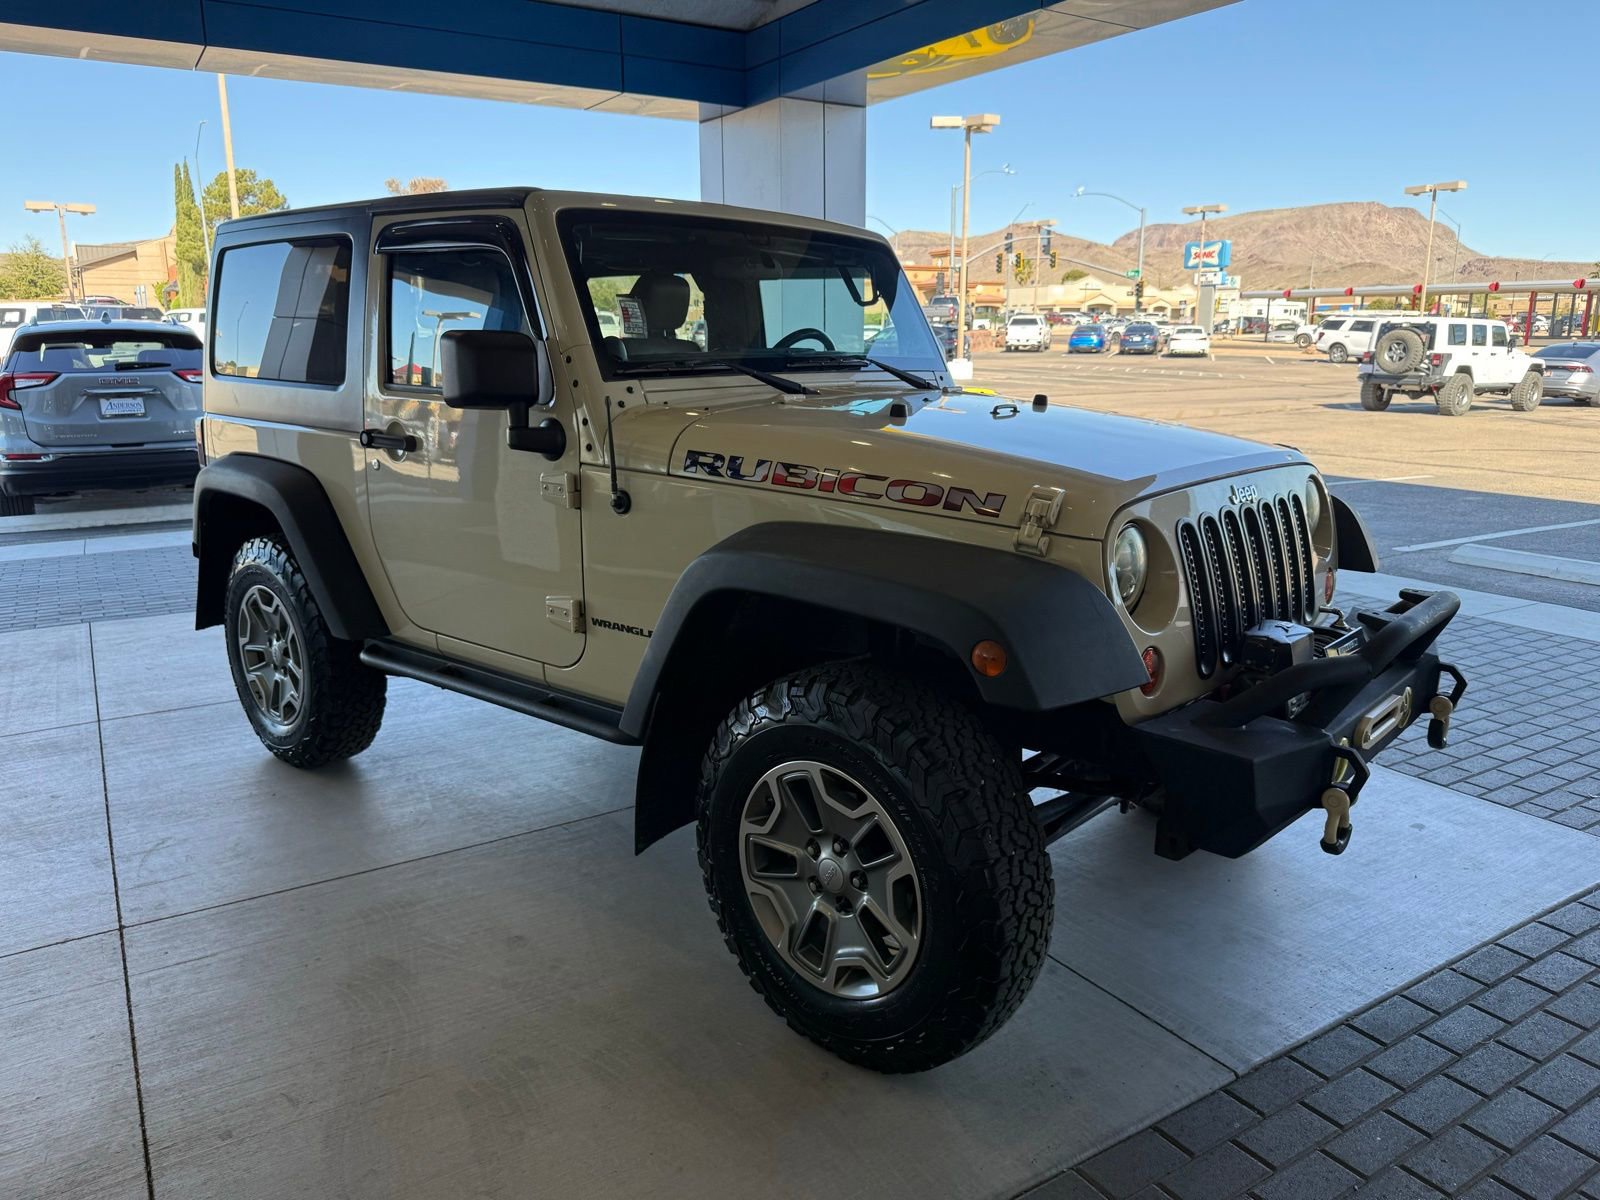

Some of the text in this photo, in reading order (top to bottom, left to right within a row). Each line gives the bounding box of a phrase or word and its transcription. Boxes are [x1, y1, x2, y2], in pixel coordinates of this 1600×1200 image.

[98, 376, 140, 385] GMC
[104, 401, 143, 412] ANDERSON
[683, 449, 1007, 518] RUBICON
[1229, 484, 1258, 505] Jeep
